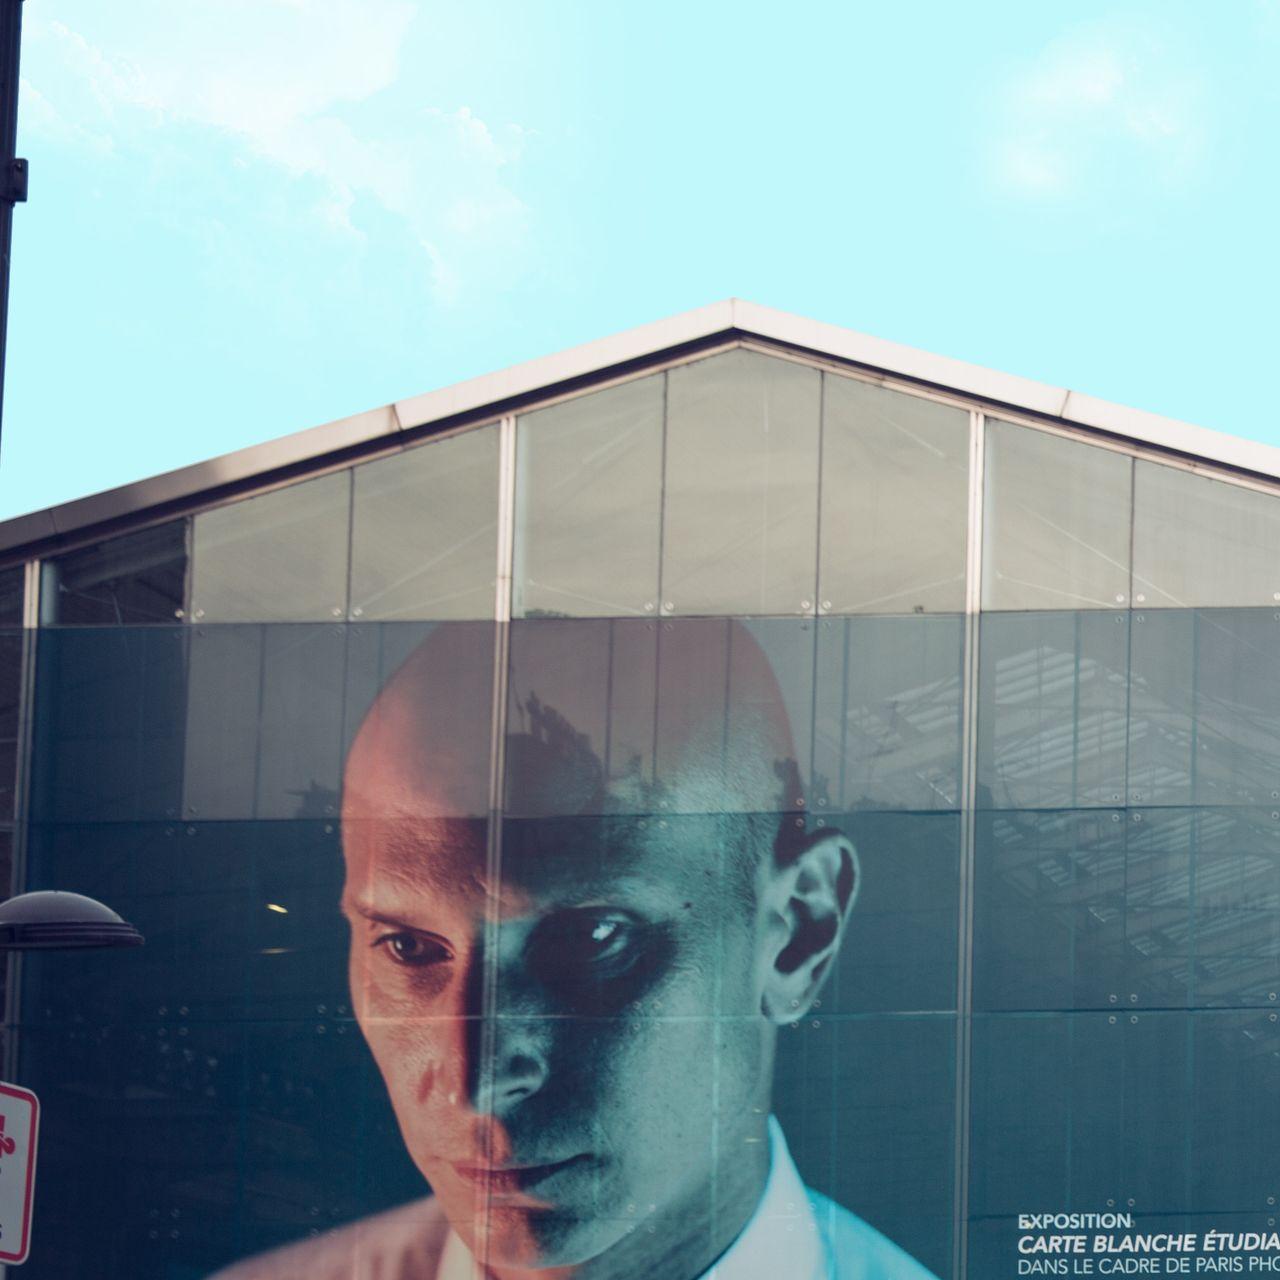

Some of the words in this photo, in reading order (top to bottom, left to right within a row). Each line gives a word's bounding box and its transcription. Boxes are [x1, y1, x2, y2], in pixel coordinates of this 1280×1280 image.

[1018, 1213, 1131, 1229] EXPOSITION
[1018, 1235, 1087, 1254] CARTE
[1093, 1234, 1197, 1253] BLANCHE
[1018, 1259, 1068, 1275] DANS
[1074, 1259, 1093, 1274] LE
[1099, 1258, 1160, 1274] CADRE
[1166, 1258, 1191, 1273] DE
[1196, 1257, 1243, 1272] PARIS
